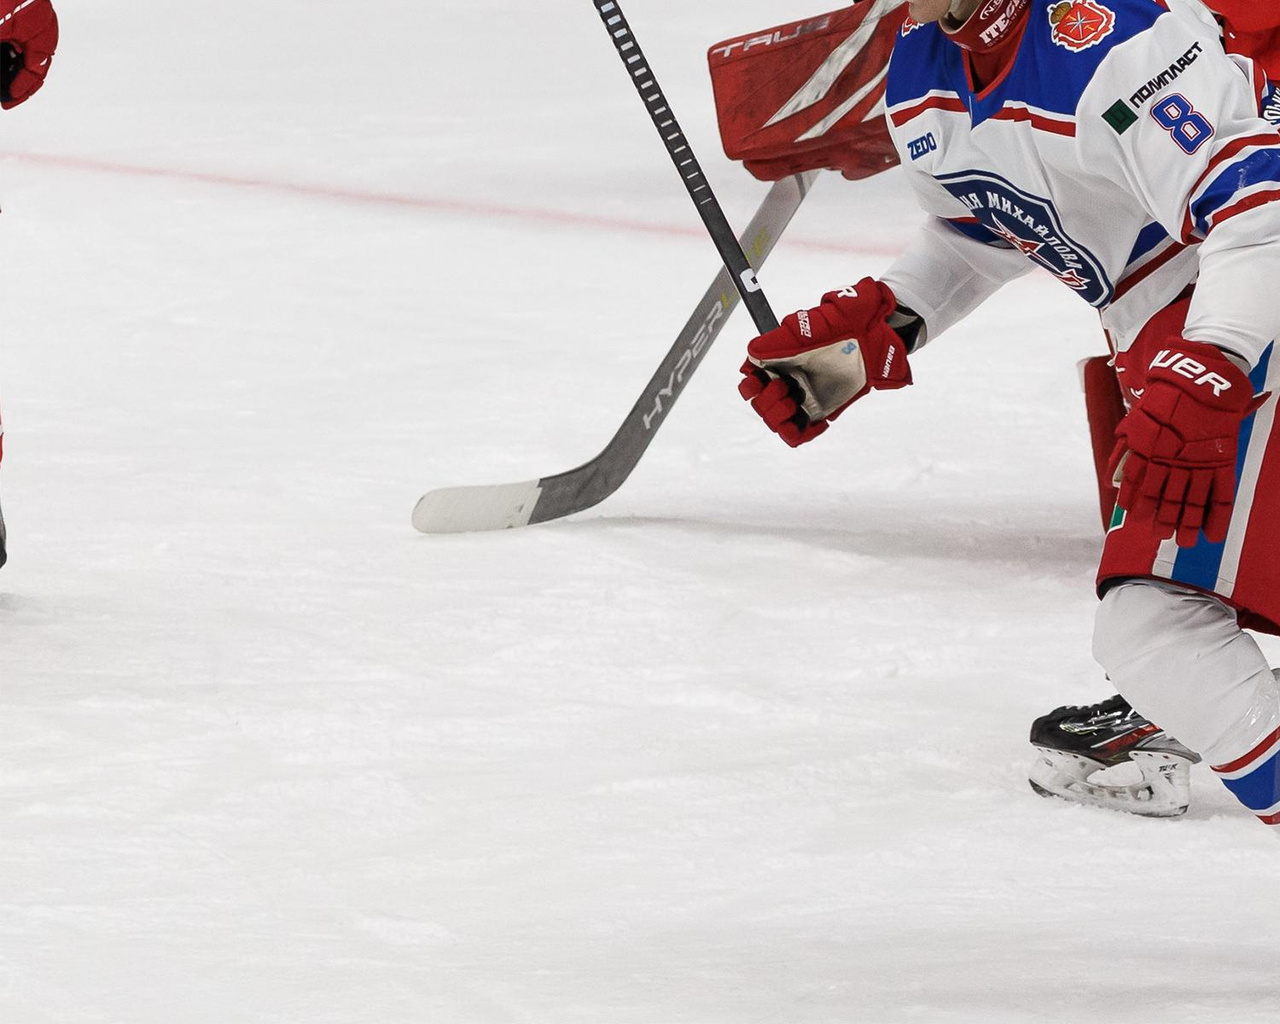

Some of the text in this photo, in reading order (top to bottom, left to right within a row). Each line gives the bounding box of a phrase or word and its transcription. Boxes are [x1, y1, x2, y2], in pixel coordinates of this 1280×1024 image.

[1129, 41, 1204, 109] ПОЛИПЛАСТ
[906, 131, 938, 162] ZEDO
[1150, 93, 1215, 156] 8
[986, 190, 1084, 270] МИХАЙЛОВА
